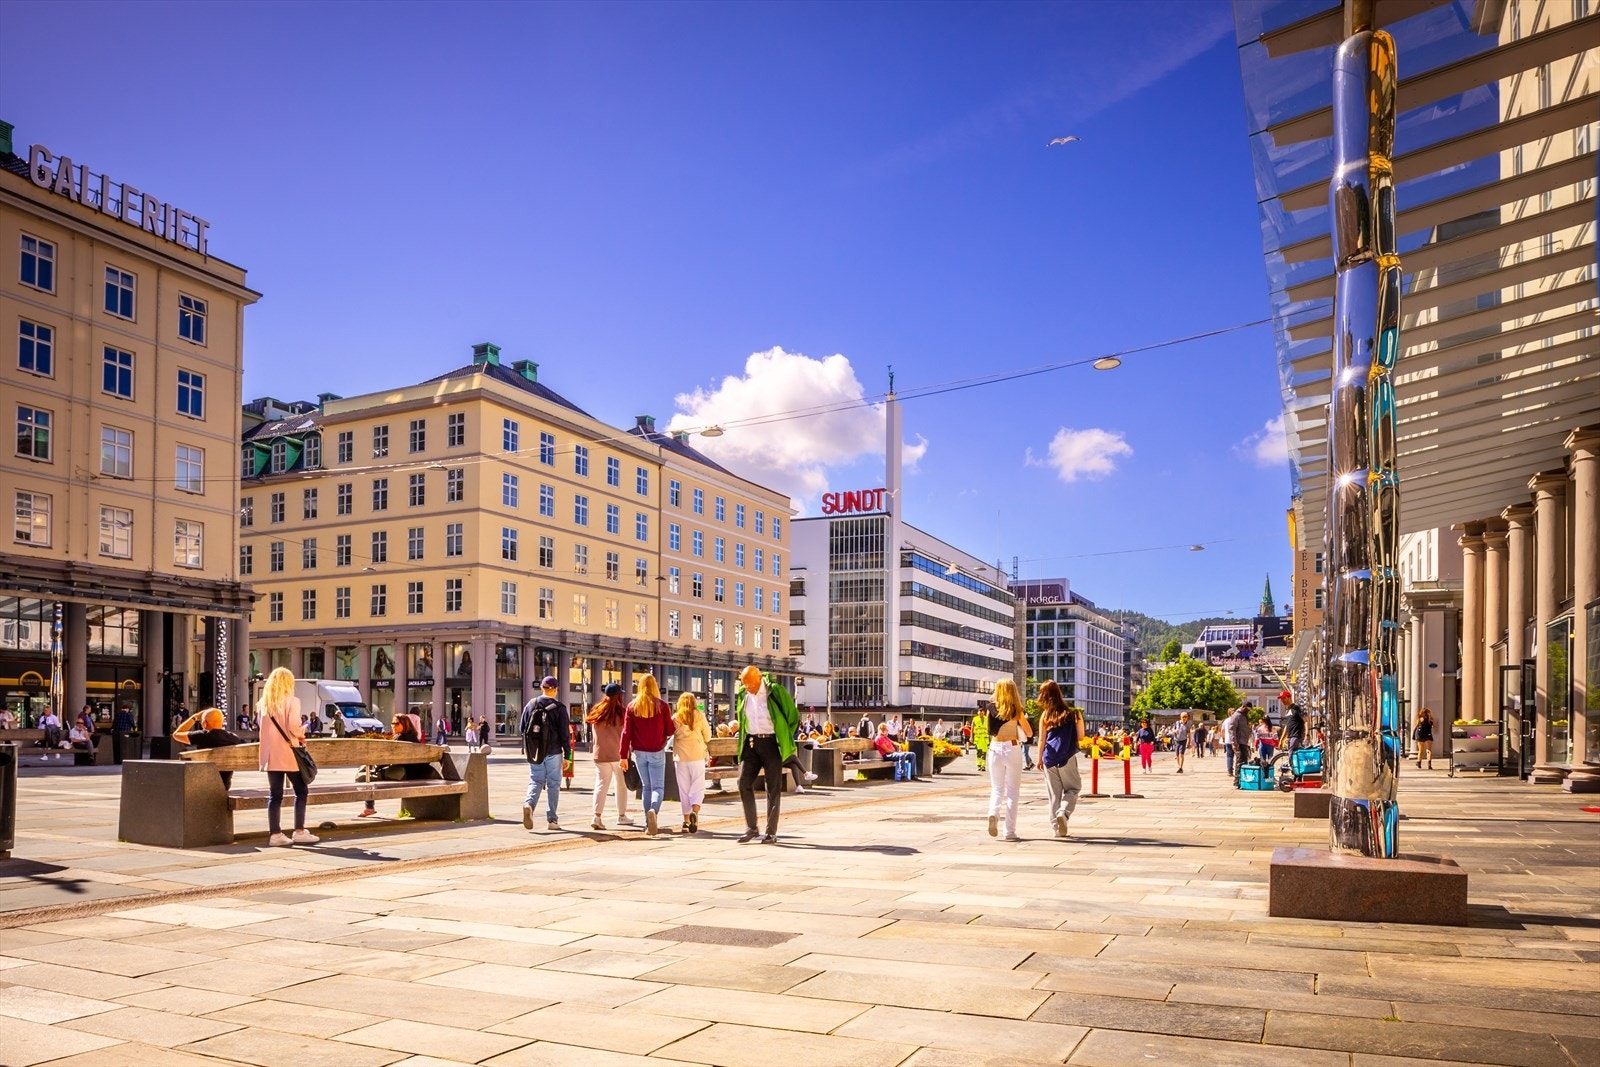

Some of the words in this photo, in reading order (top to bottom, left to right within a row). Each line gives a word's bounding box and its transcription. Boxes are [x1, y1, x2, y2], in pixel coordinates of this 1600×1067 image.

[29, 144, 210, 255] GALLERIET
[822, 488, 887, 514] SUNDT
[1030, 596, 1060, 604] NORGE
